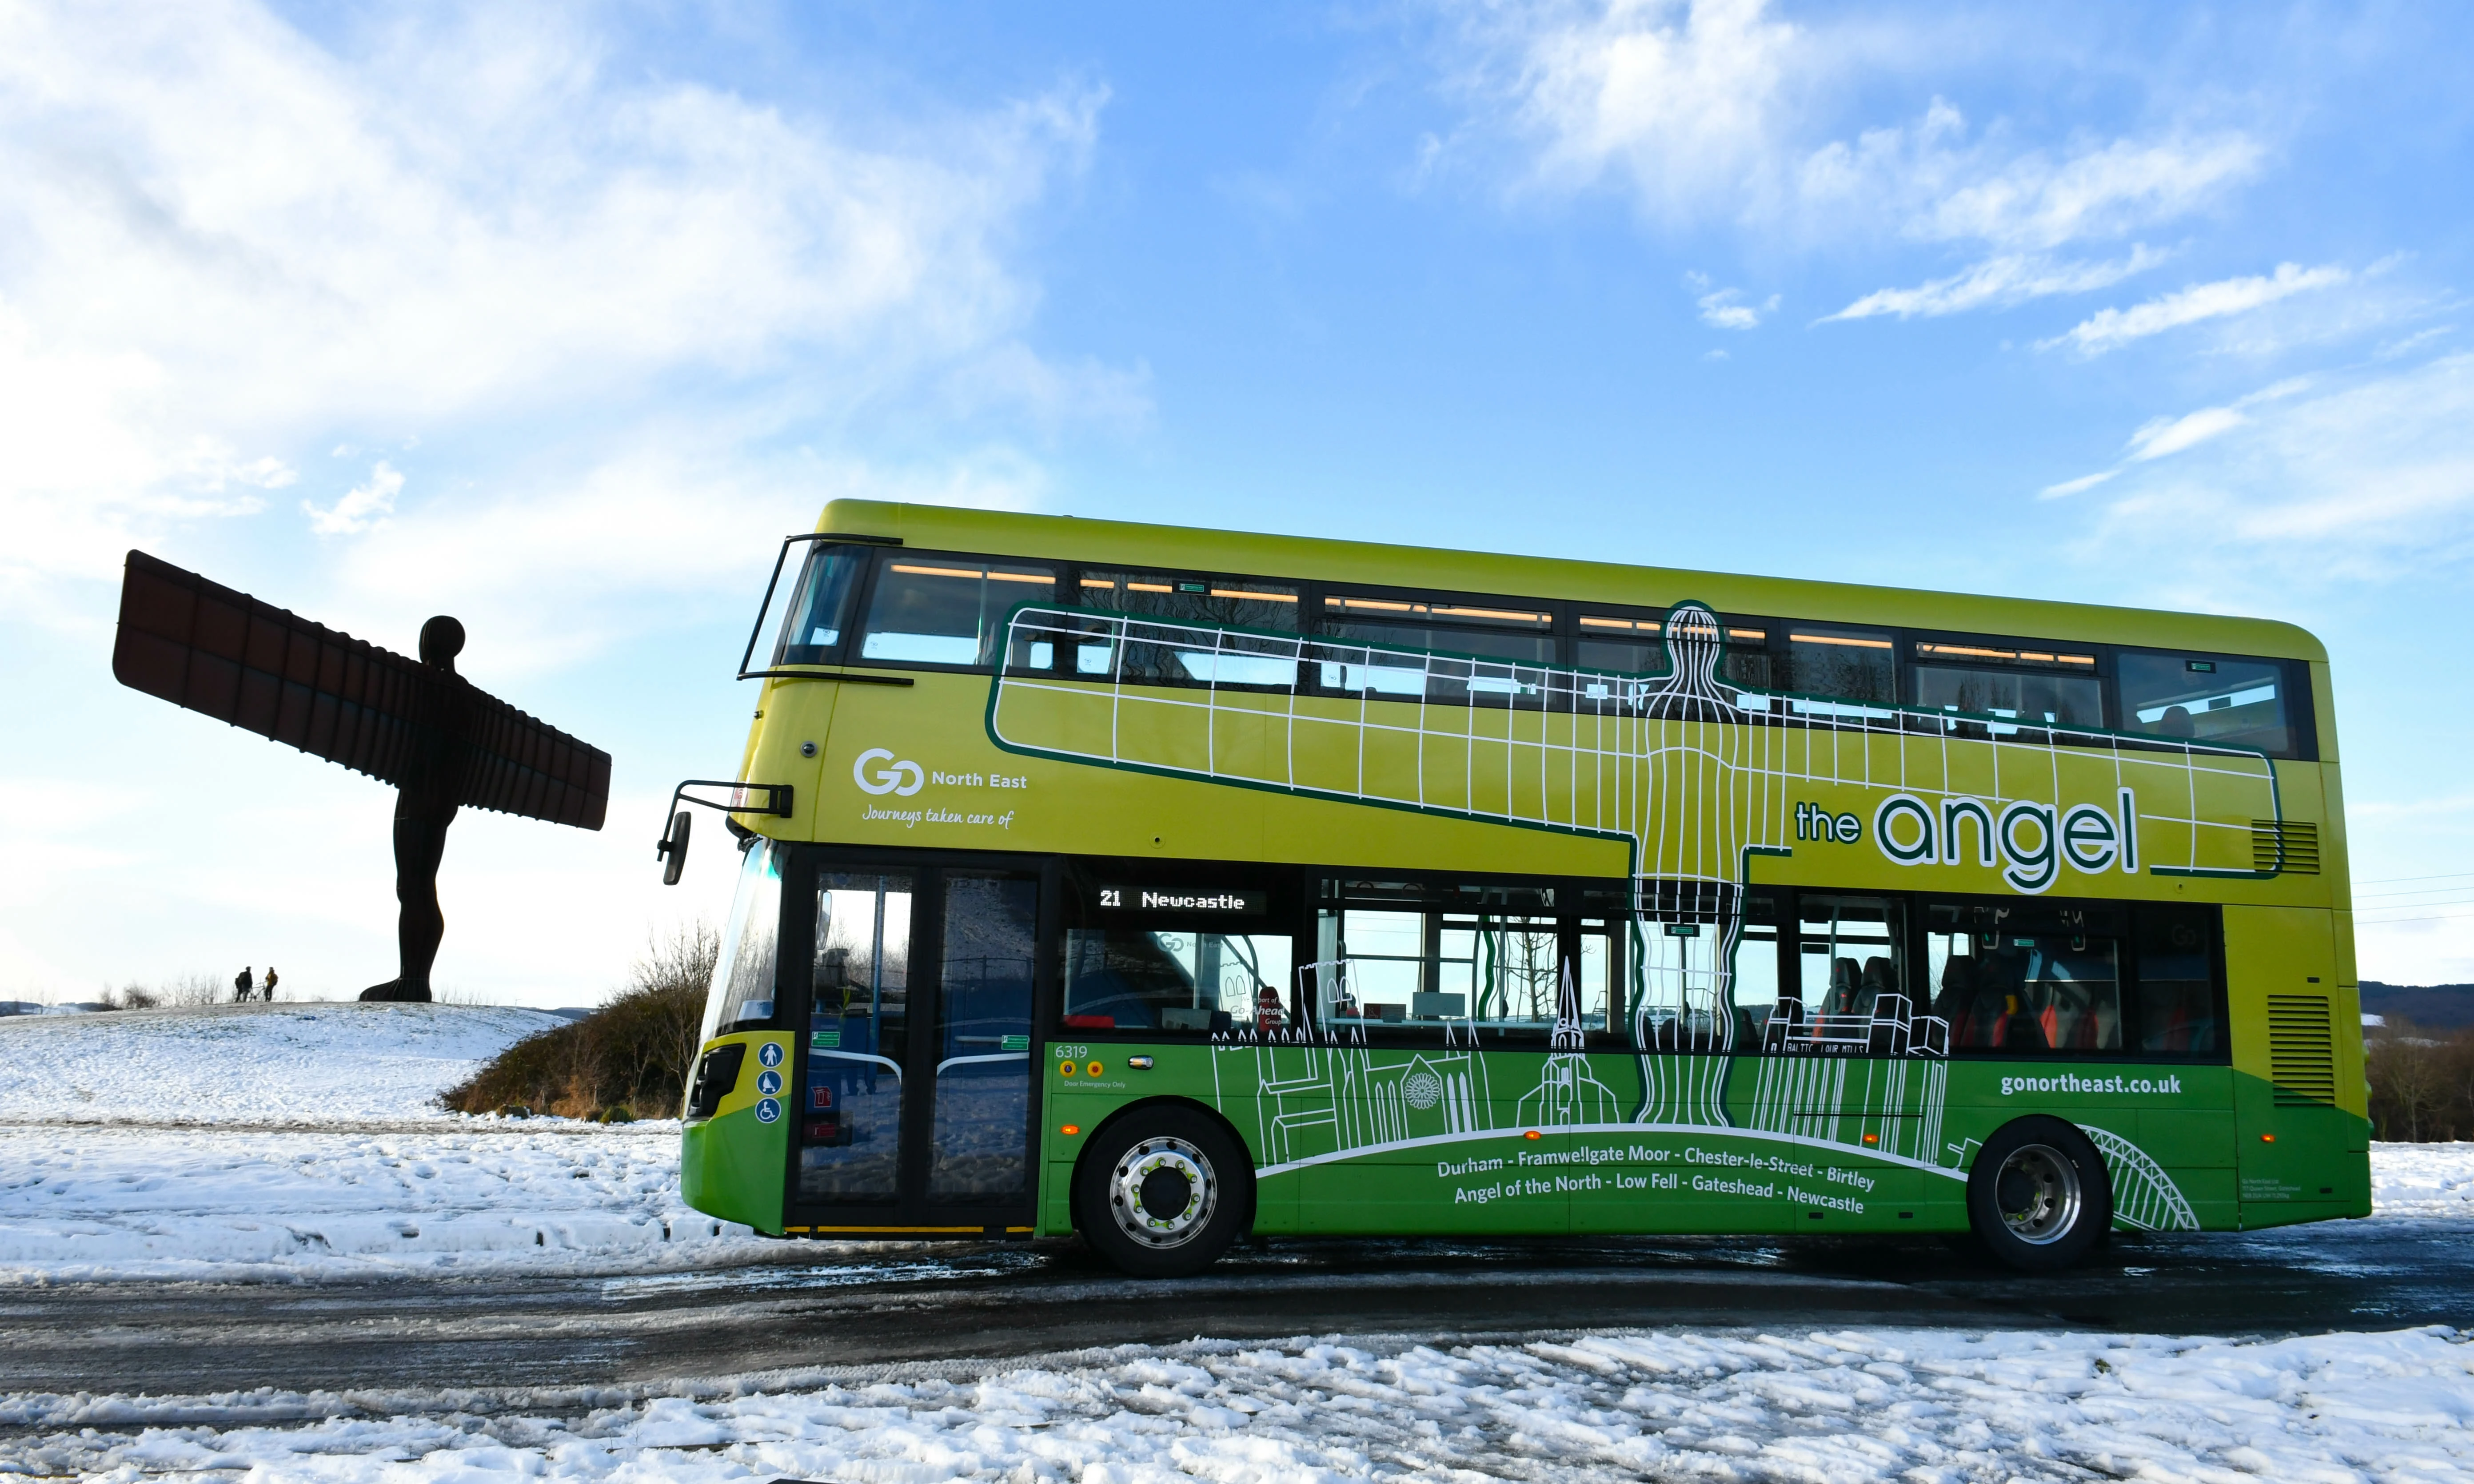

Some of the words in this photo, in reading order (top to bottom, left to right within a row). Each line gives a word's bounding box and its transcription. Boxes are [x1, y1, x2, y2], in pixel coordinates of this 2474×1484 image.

[854, 748, 924, 796] Go
[932, 771, 983, 786] North
[990, 774, 1027, 789] East
[862, 804, 922, 828] Journeys
[926, 808, 963, 823] taken
[967, 812, 994, 824] care
[998, 811, 1014, 829] of
[1796, 801, 1862, 844] the
[1873, 787, 2139, 895] angel
[1100, 890, 1121, 907] 21
[1142, 891, 1245, 909] Newcastle
[1230, 1005, 1285, 1016] Go-Ahead
[1265, 1018, 1282, 1026] Group
[1055, 1045, 1087, 1058] 6319
[2001, 1073, 2181, 1095] gonortheast.co.uk
[1437, 1157, 1503, 1177] Durham
[1518, 1146, 1624, 1166] Framwellgate
[1628, 1145, 1671, 1161] Moor
[1684, 1147, 1813, 1178] Chester-le-Street
[1827, 1166, 1875, 1193] Birtley
[1455, 1182, 1501, 1204] Angel
[1505, 1179, 1521, 1196] of
[1525, 1178, 1551, 1195] the
[1555, 1174, 1601, 1192] North
[1616, 1173, 1647, 1189] Low
[1651, 1173, 1678, 1189] Fell
[1692, 1175, 1774, 1198] Gateshead
[1787, 1186, 1864, 1214] Newcastle
